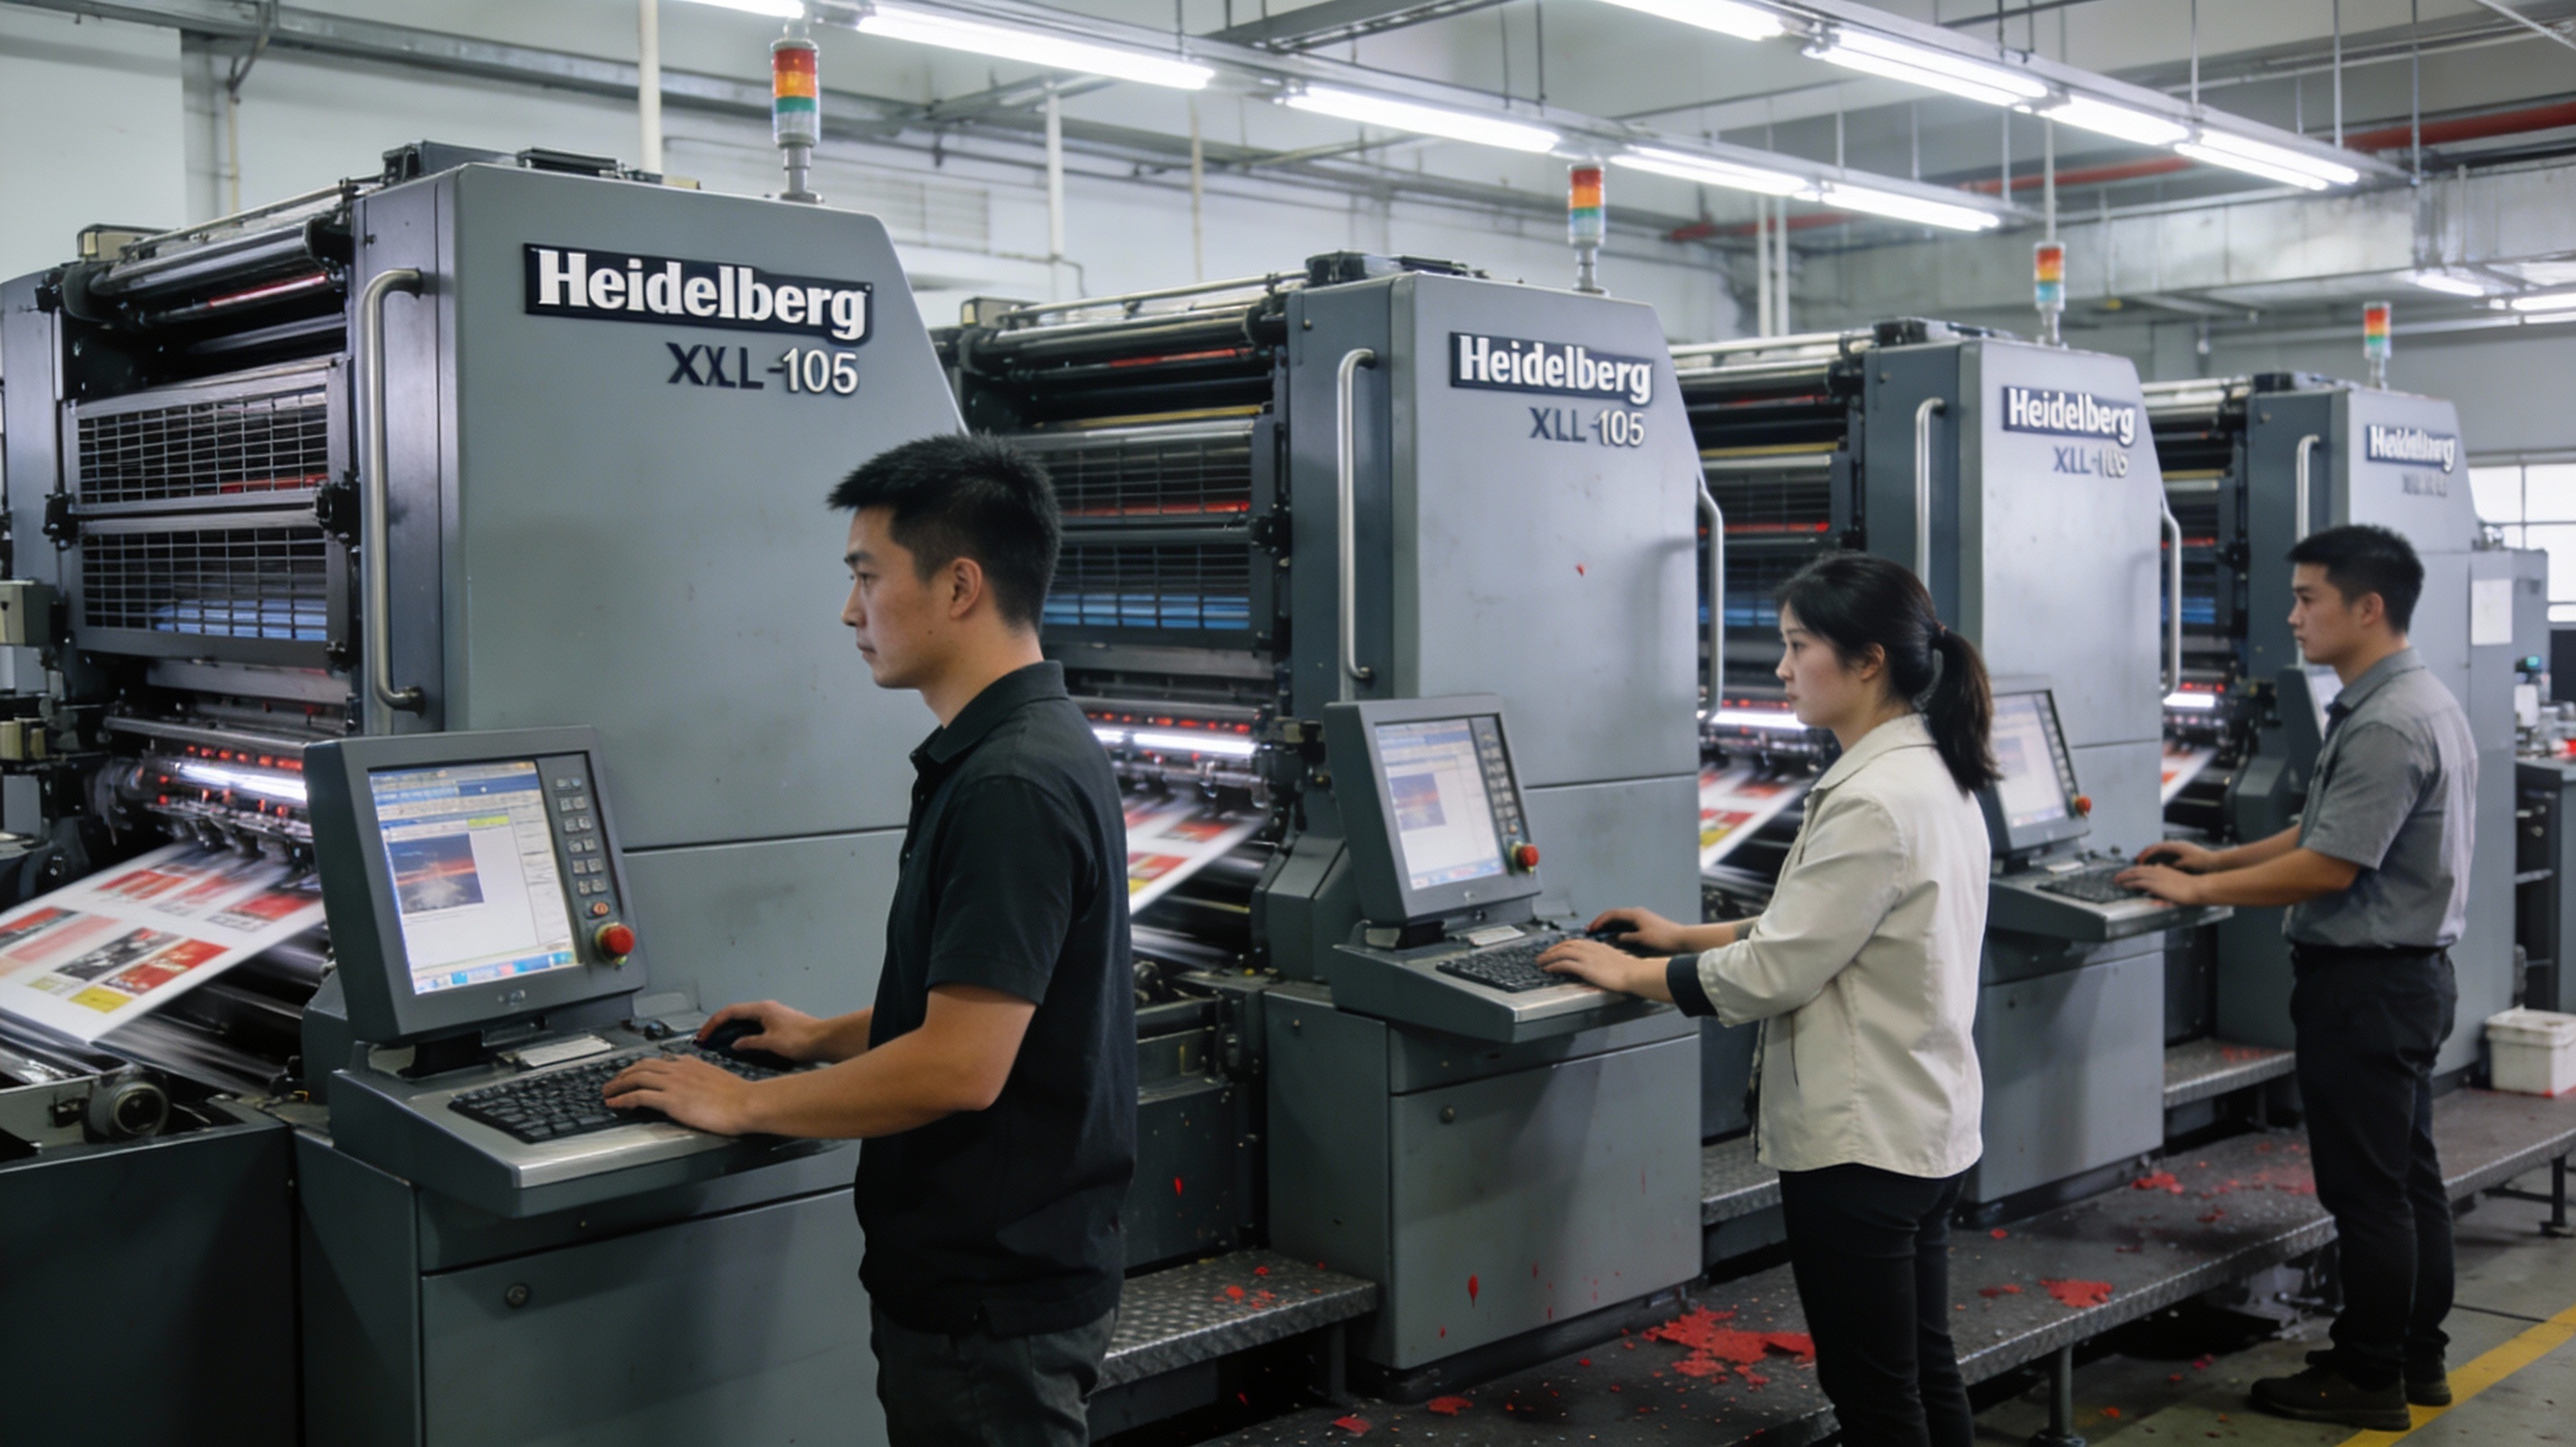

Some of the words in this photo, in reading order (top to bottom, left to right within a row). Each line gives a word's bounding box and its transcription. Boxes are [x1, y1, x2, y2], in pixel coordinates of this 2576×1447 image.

[539, 249, 867, 341] Heidelberg
[666, 342, 859, 395] XXL-105
[1459, 335, 1653, 406] Heidelberg
[1529, 407, 1644, 448] XLL-105
[2009, 388, 2135, 446] Heidelberg
